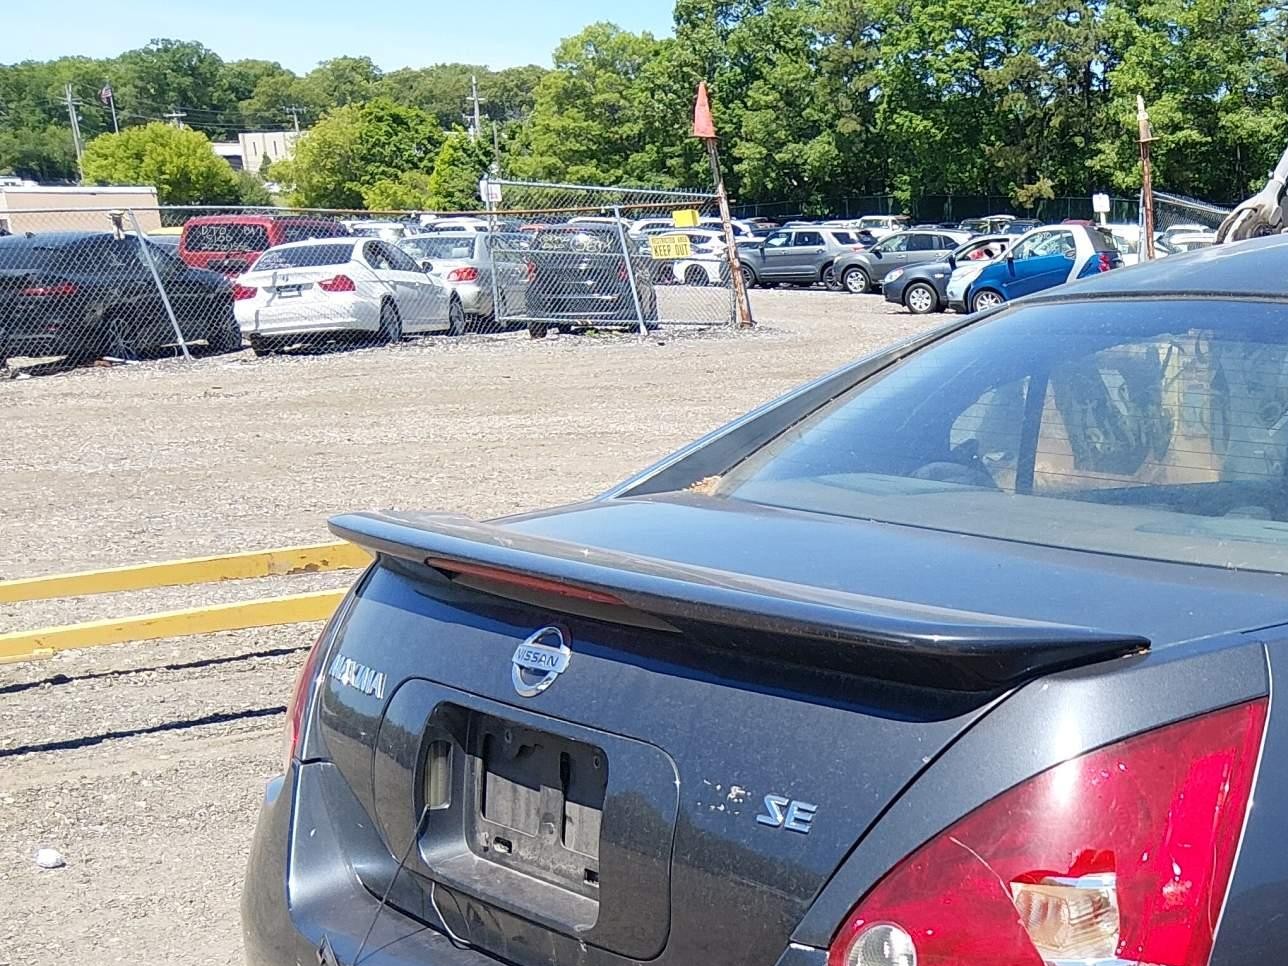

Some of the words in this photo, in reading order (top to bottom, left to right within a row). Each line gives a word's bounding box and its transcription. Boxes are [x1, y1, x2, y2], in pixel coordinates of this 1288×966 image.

[653, 244, 671, 257] KEEP
[674, 243, 689, 256] OUT
[517, 647, 560, 667] NISSAN
[328, 654, 388, 699] MAXIMA
[756, 794, 819, 835] SE
